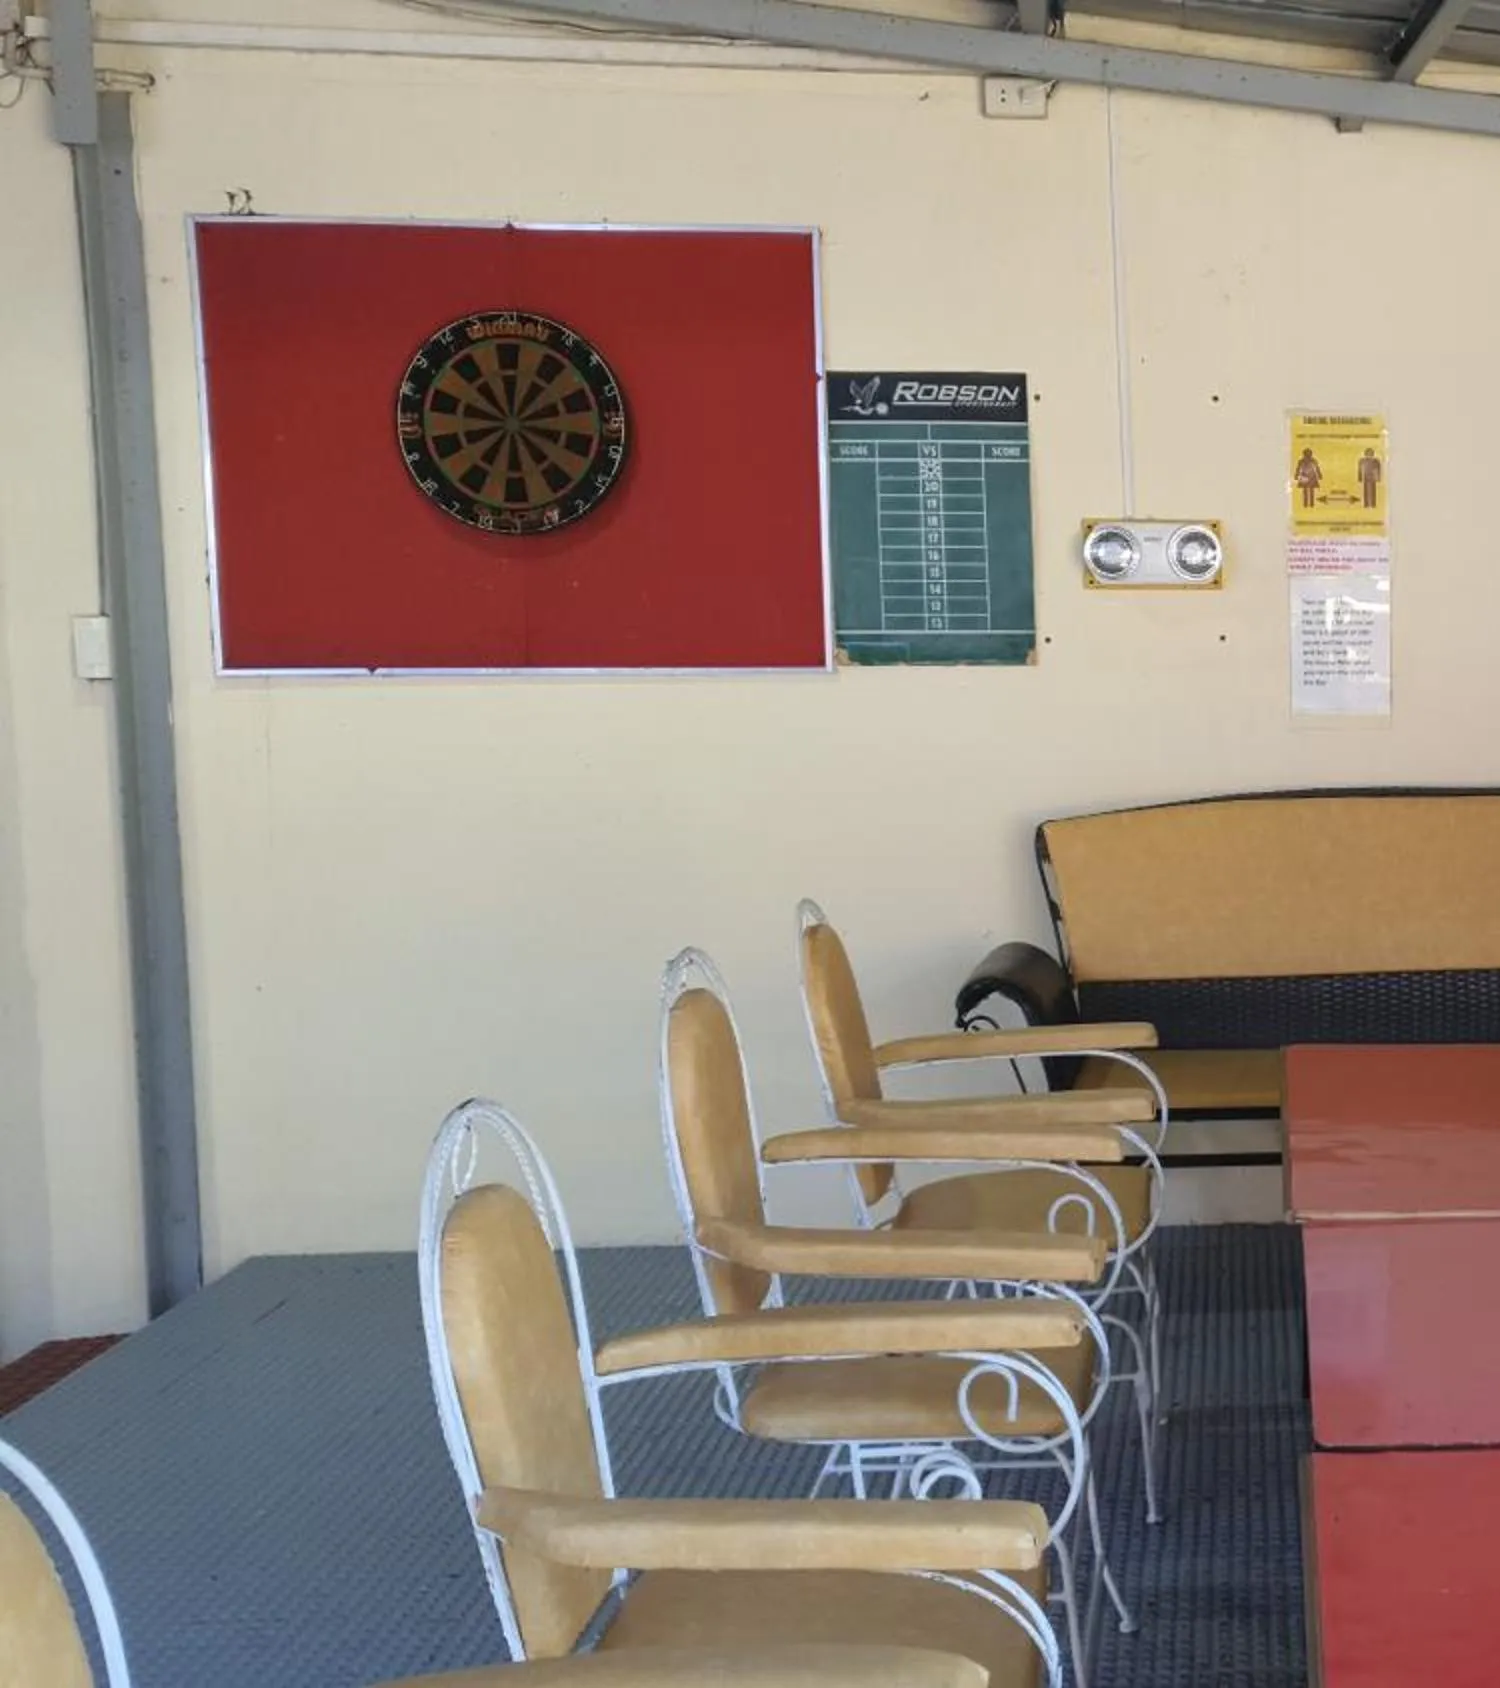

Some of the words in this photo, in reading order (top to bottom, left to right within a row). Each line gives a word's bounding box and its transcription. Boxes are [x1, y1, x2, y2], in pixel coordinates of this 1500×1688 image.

[892, 381, 1020, 401] ROBSON
[922, 445, 937, 456] VS
[992, 447, 1021, 457] SCORE
[924, 481, 938, 493] 20
